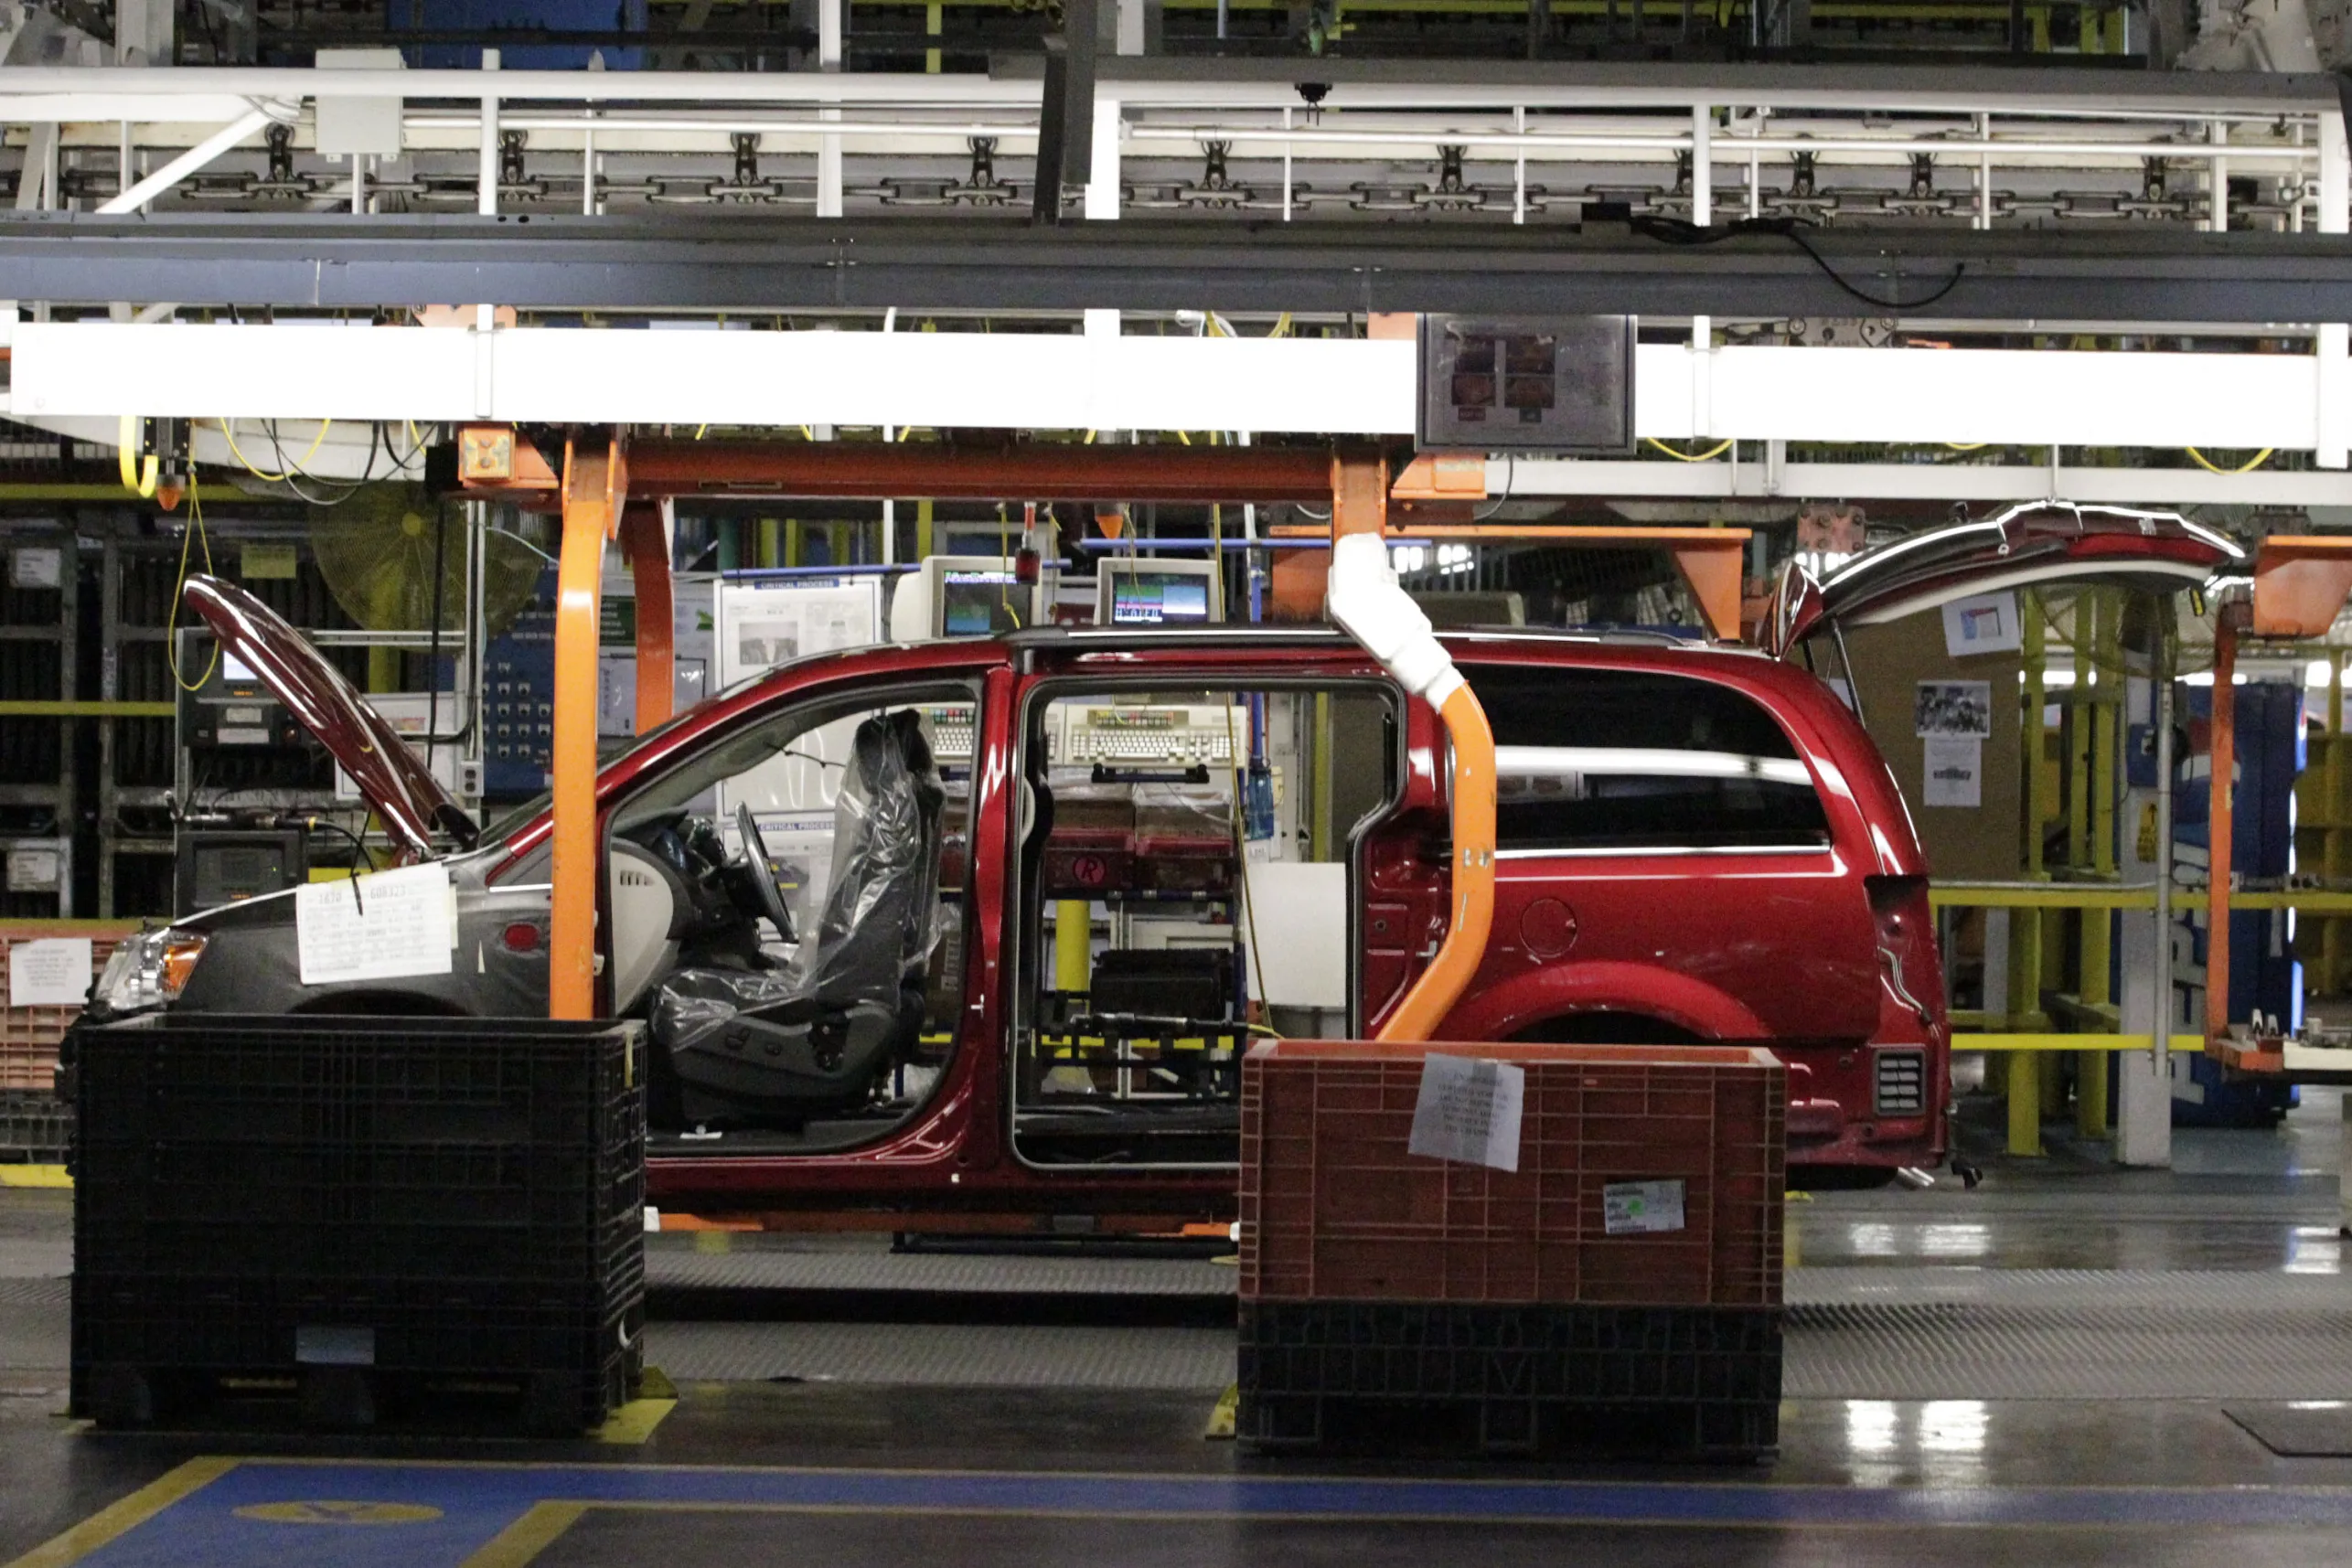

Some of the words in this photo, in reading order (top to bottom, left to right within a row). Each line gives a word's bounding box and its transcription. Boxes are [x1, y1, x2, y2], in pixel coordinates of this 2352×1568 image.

[760, 581, 795, 590] CRITICAL
[797, 580, 834, 589] PROCESS
[760, 823, 795, 831] CRITICAL
